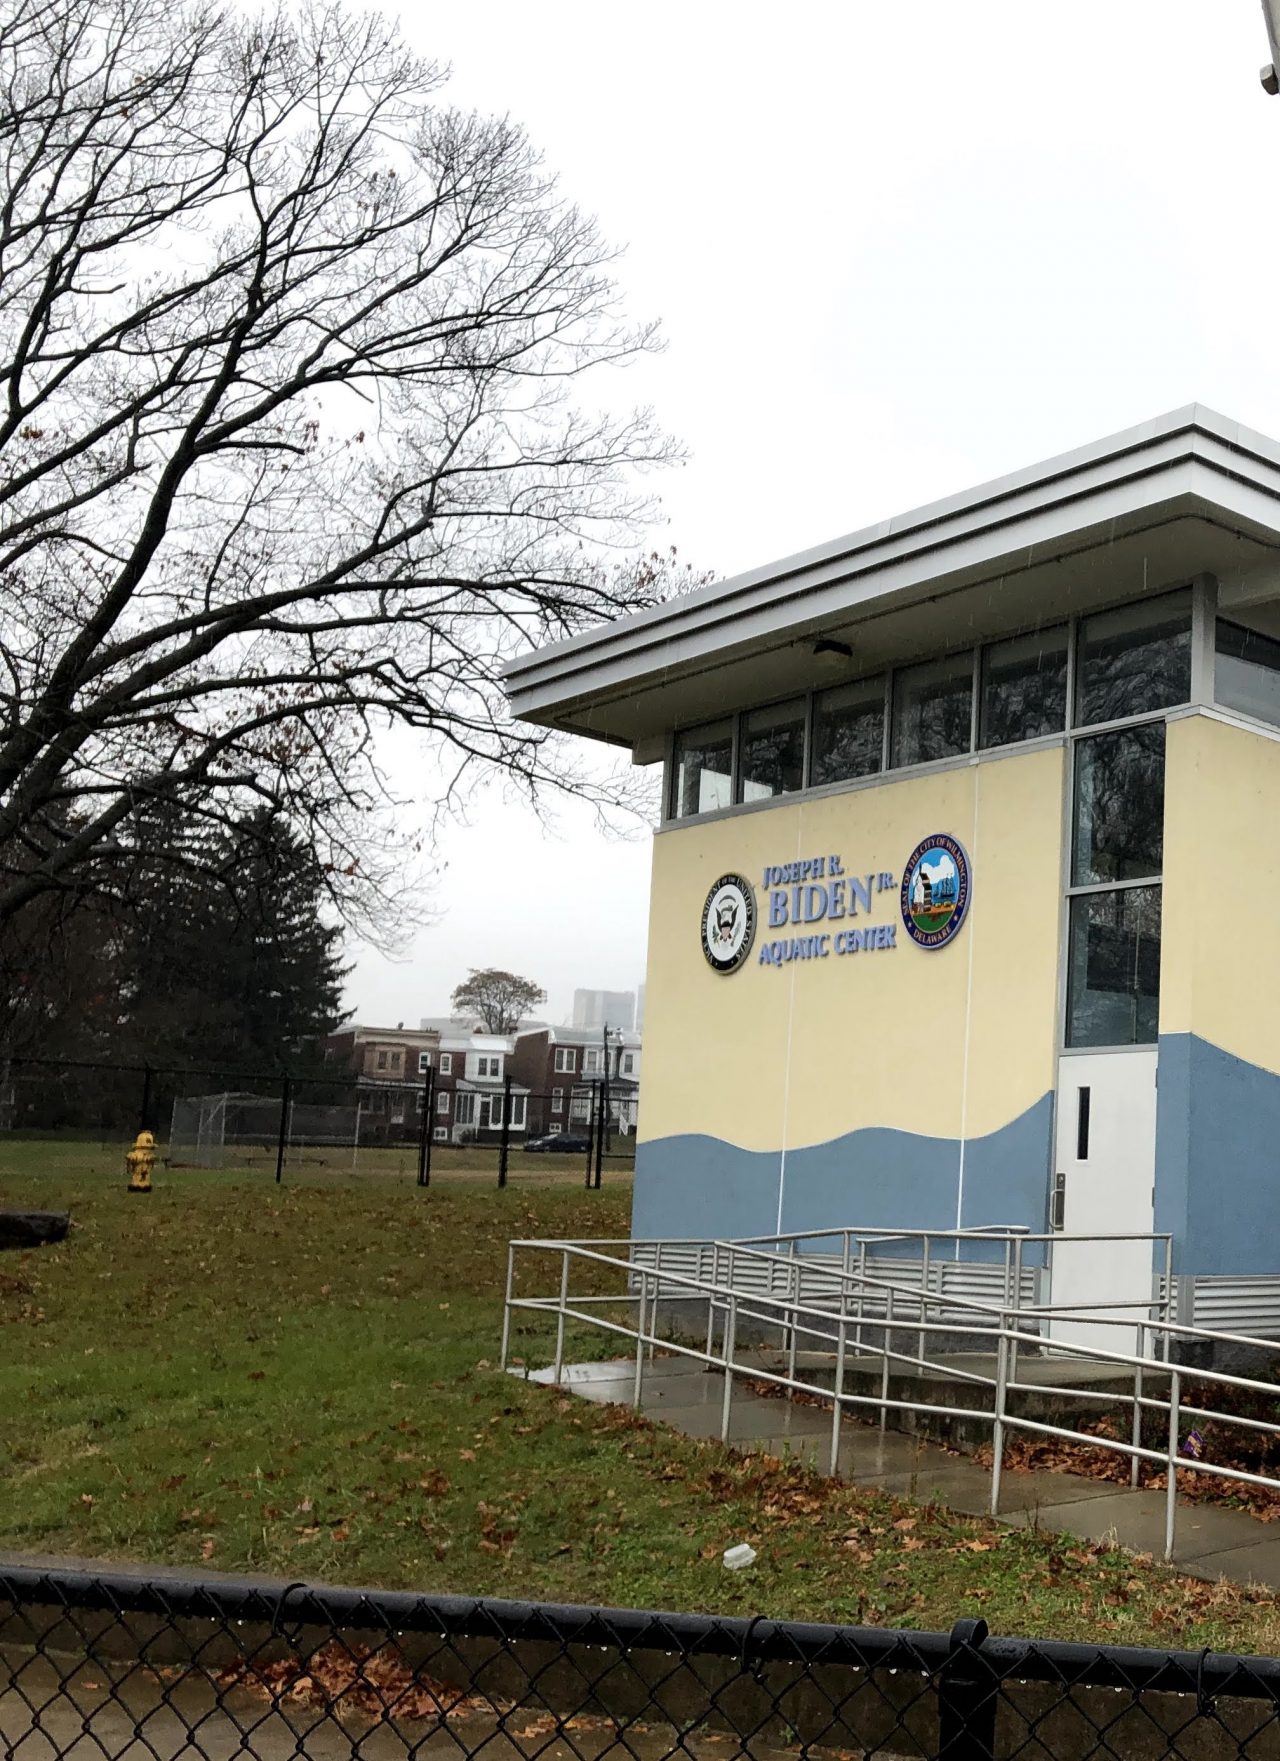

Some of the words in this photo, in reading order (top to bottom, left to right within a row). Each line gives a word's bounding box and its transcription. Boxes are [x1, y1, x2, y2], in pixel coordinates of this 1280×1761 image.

[762, 857, 826, 891] JOSEPH
[828, 855, 845, 877] R.
[904, 873, 910, 887] OF
[908, 850, 920, 869] THE
[920, 839, 935, 853] CITY
[937, 837, 945, 846] OF
[946, 839, 966, 906] WILMINGTON
[768, 874, 875, 928] BIDEN
[876, 871, 898, 893] JR.
[759, 934, 831, 967] AQUATIC
[833, 924, 897, 955] CENTER
[913, 926, 952, 945] DELAWARE
